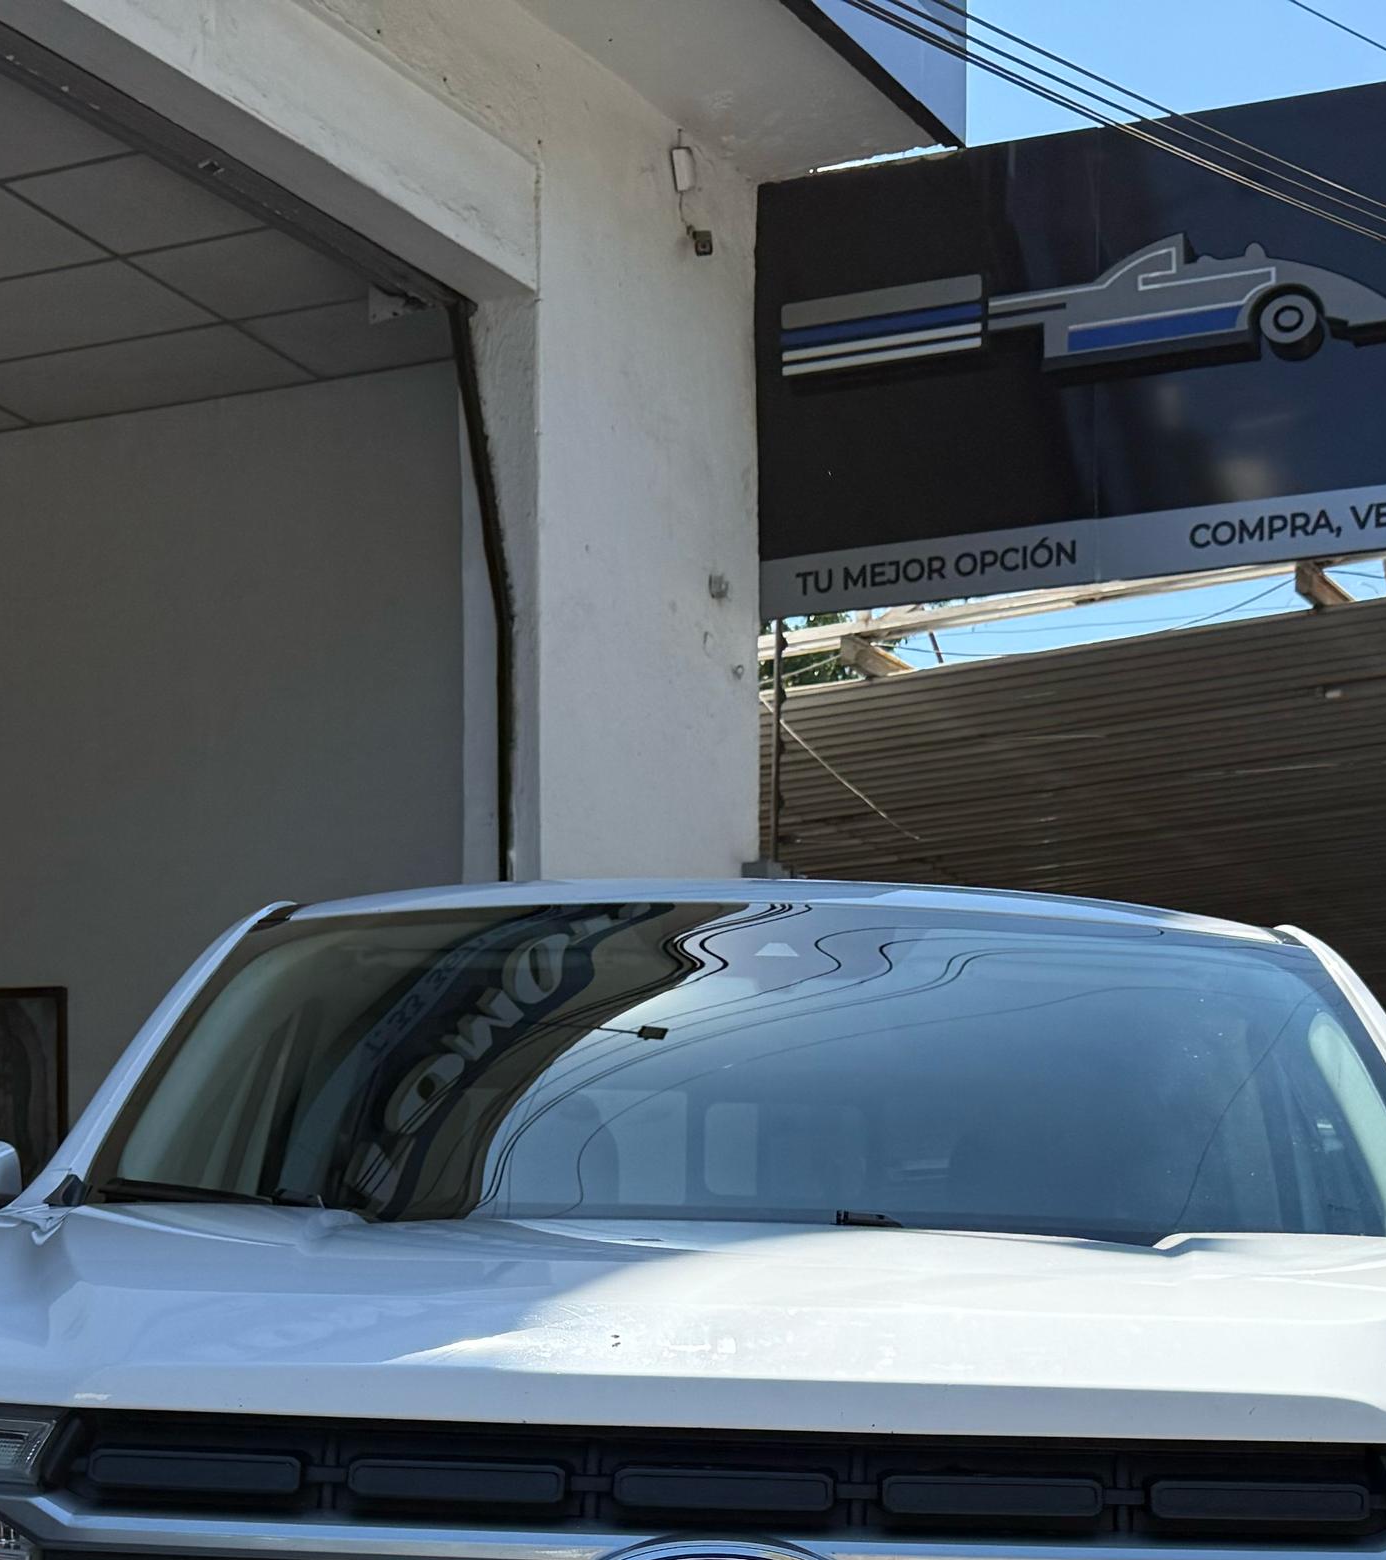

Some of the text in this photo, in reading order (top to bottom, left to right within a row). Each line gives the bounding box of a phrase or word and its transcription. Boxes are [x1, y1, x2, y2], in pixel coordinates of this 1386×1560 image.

[1189, 509, 1343, 549] COMPRA,
[796, 536, 1077, 596] TU MEJOR OPCIÓN
